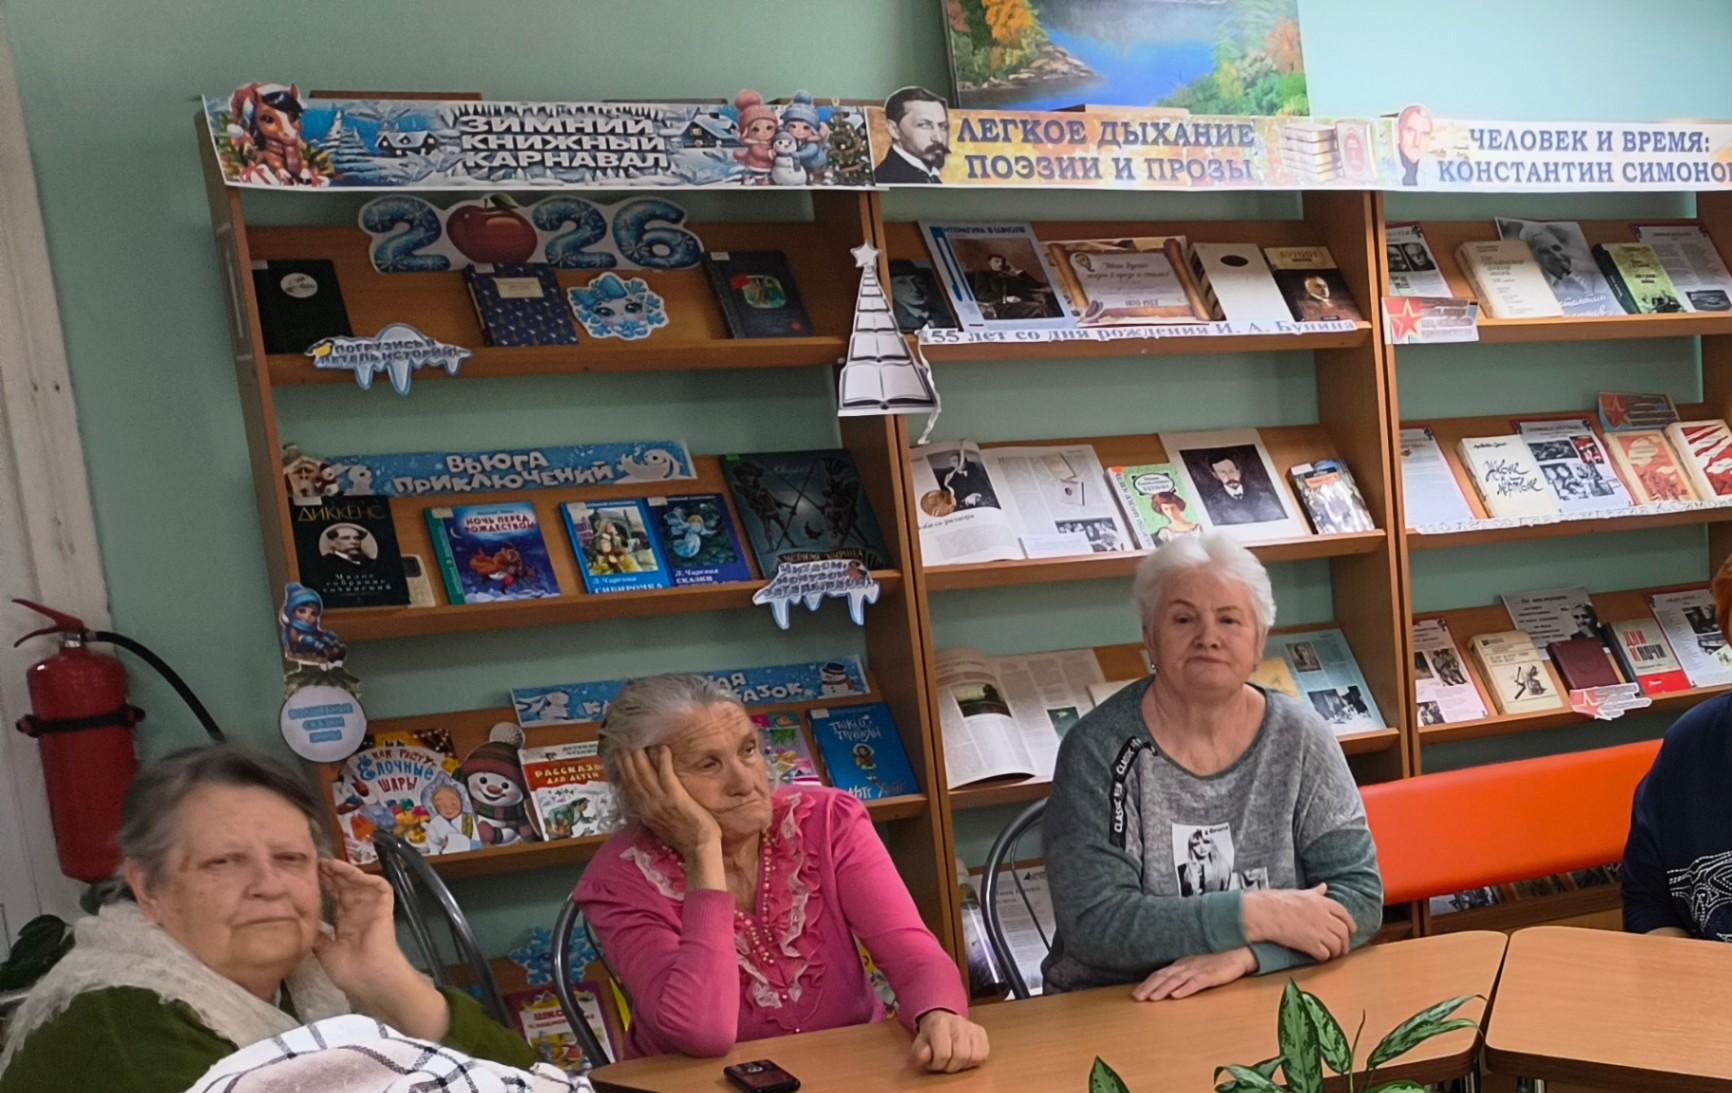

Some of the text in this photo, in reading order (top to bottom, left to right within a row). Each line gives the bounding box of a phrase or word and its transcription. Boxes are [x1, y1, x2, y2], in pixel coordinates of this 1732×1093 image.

[459, 115, 654, 134] ЗИМНИЙ
[957, 117, 1255, 149] ЛЕГКОЕ ДЫХАНИЕ
[461, 134, 665, 150] КНИЖНЫЙ
[1468, 128, 1711, 154] ЧЕЛОВЕК И ВРЕМЯ:
[464, 151, 669, 168] КАРНАВАЛ
[964, 154, 1251, 184] ПОЭЗИИ И ПРОЗЫ
[1437, 158, 1615, 184] КОНСТАНТИН
[1015, 330, 1041, 341] со
[445, 451, 549, 473] ВЬЮГА
[392, 460, 615, 494] ПРИКЛЮЧЕНИЙ
[297, 504, 387, 522] ДИККЕНС
[465, 514, 530, 526] НОЧЬ ПЕРЕД
[463, 521, 535, 533] РОЖДЕСТВОМ
[371, 749, 393, 761] КАК
[377, 777, 418, 794] ШАРЫ
